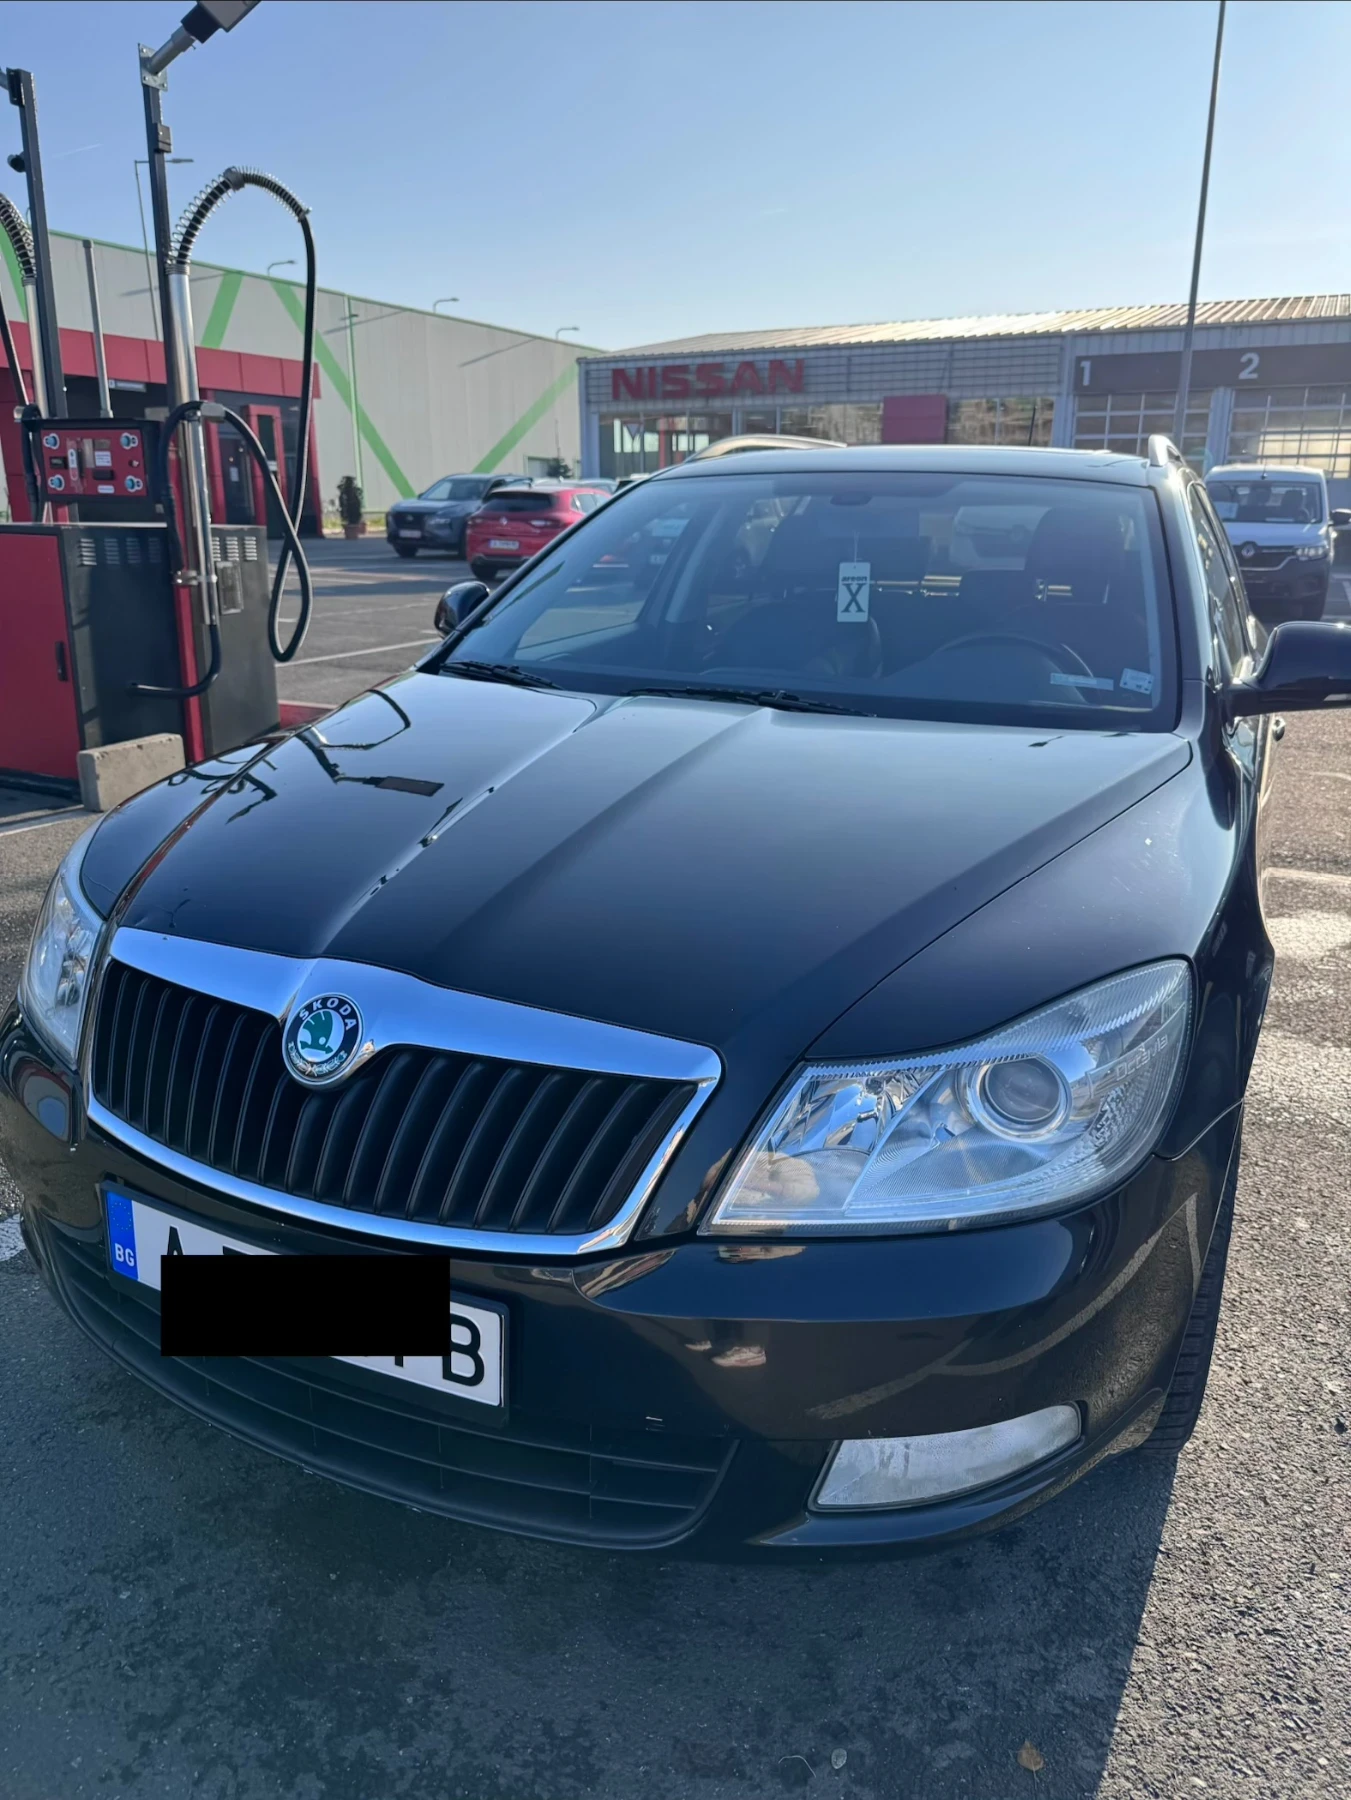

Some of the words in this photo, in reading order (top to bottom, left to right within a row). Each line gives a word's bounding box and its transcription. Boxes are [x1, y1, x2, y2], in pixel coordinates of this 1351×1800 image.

[611, 358, 805, 400] NISSAN
[1080, 360, 1092, 387] 1
[1238, 352, 1260, 380] 2
[840, 583, 869, 613] X
[114, 1243, 135, 1268] BG
